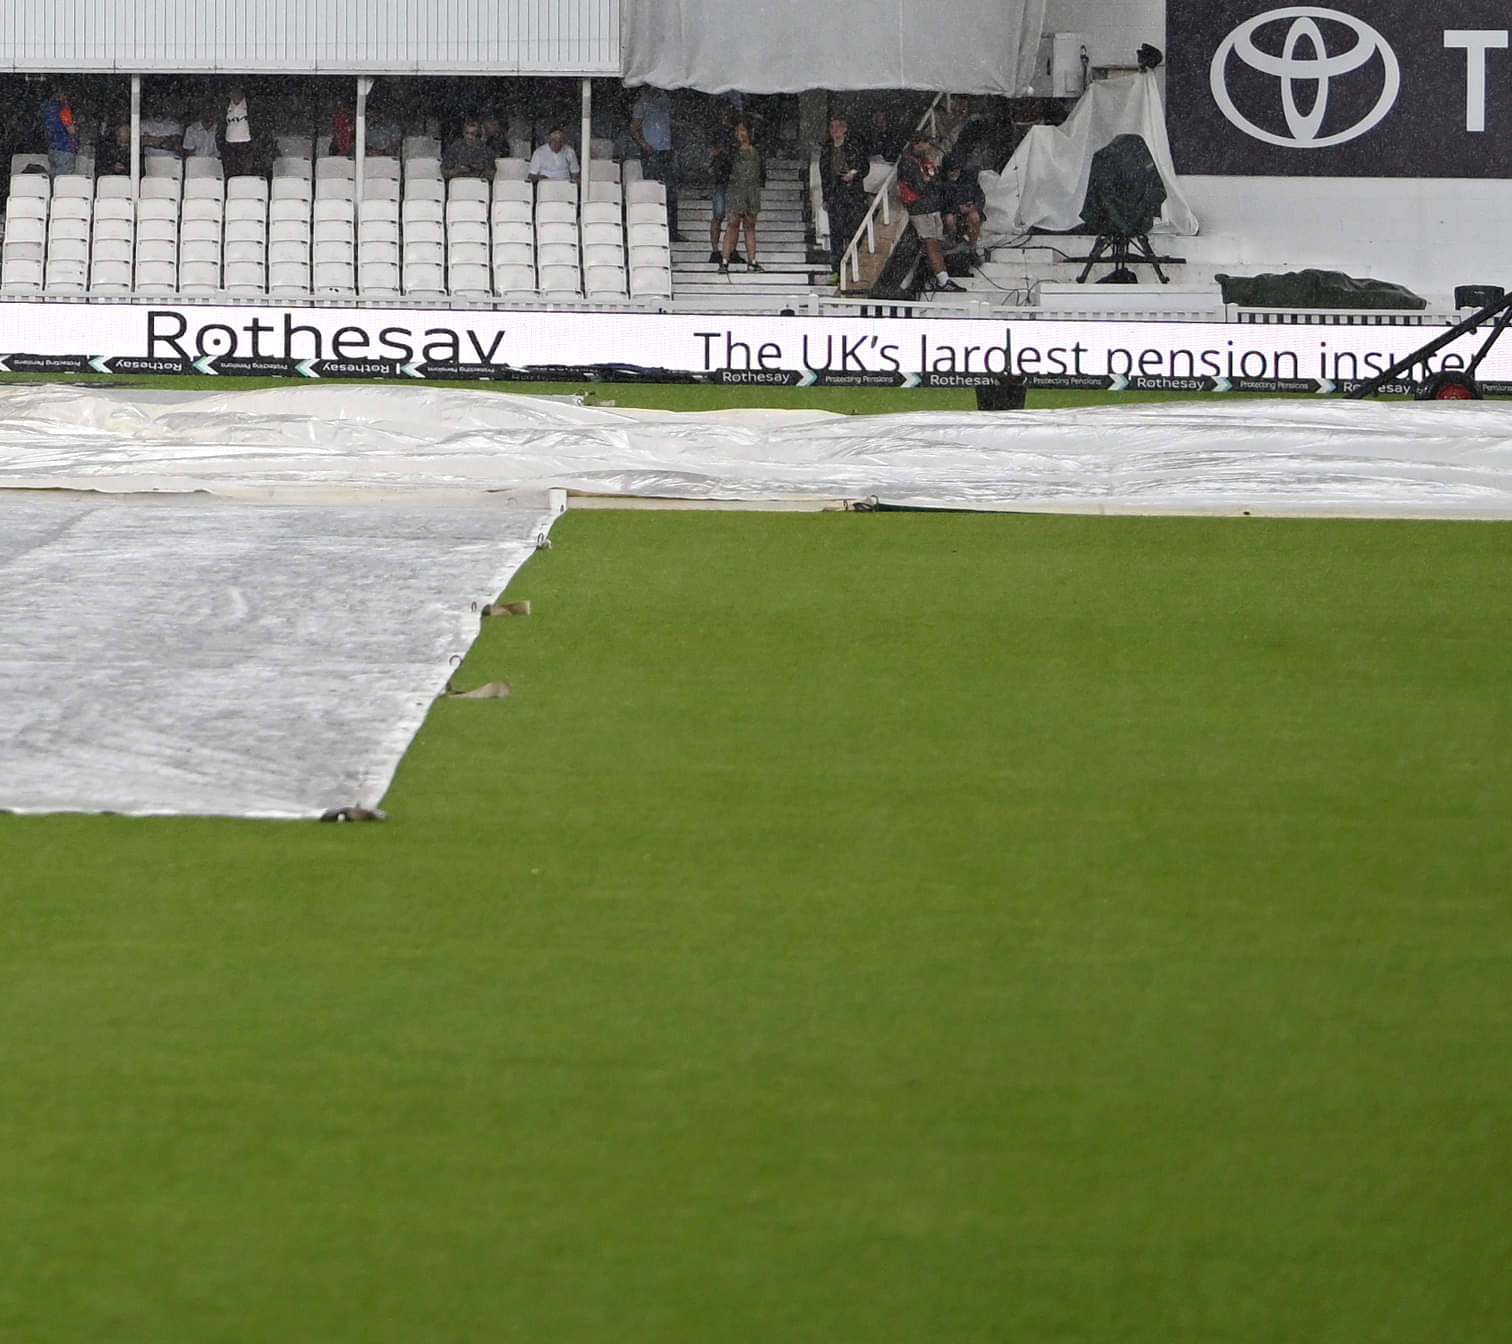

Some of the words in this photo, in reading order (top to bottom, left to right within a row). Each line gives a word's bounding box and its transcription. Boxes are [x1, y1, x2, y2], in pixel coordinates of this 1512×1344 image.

[148, 311, 505, 365] Rothesay
[694, 331, 782, 371] The
[723, 372, 790, 383] Rothesay
[1138, 378, 1204, 390] Rothesay
